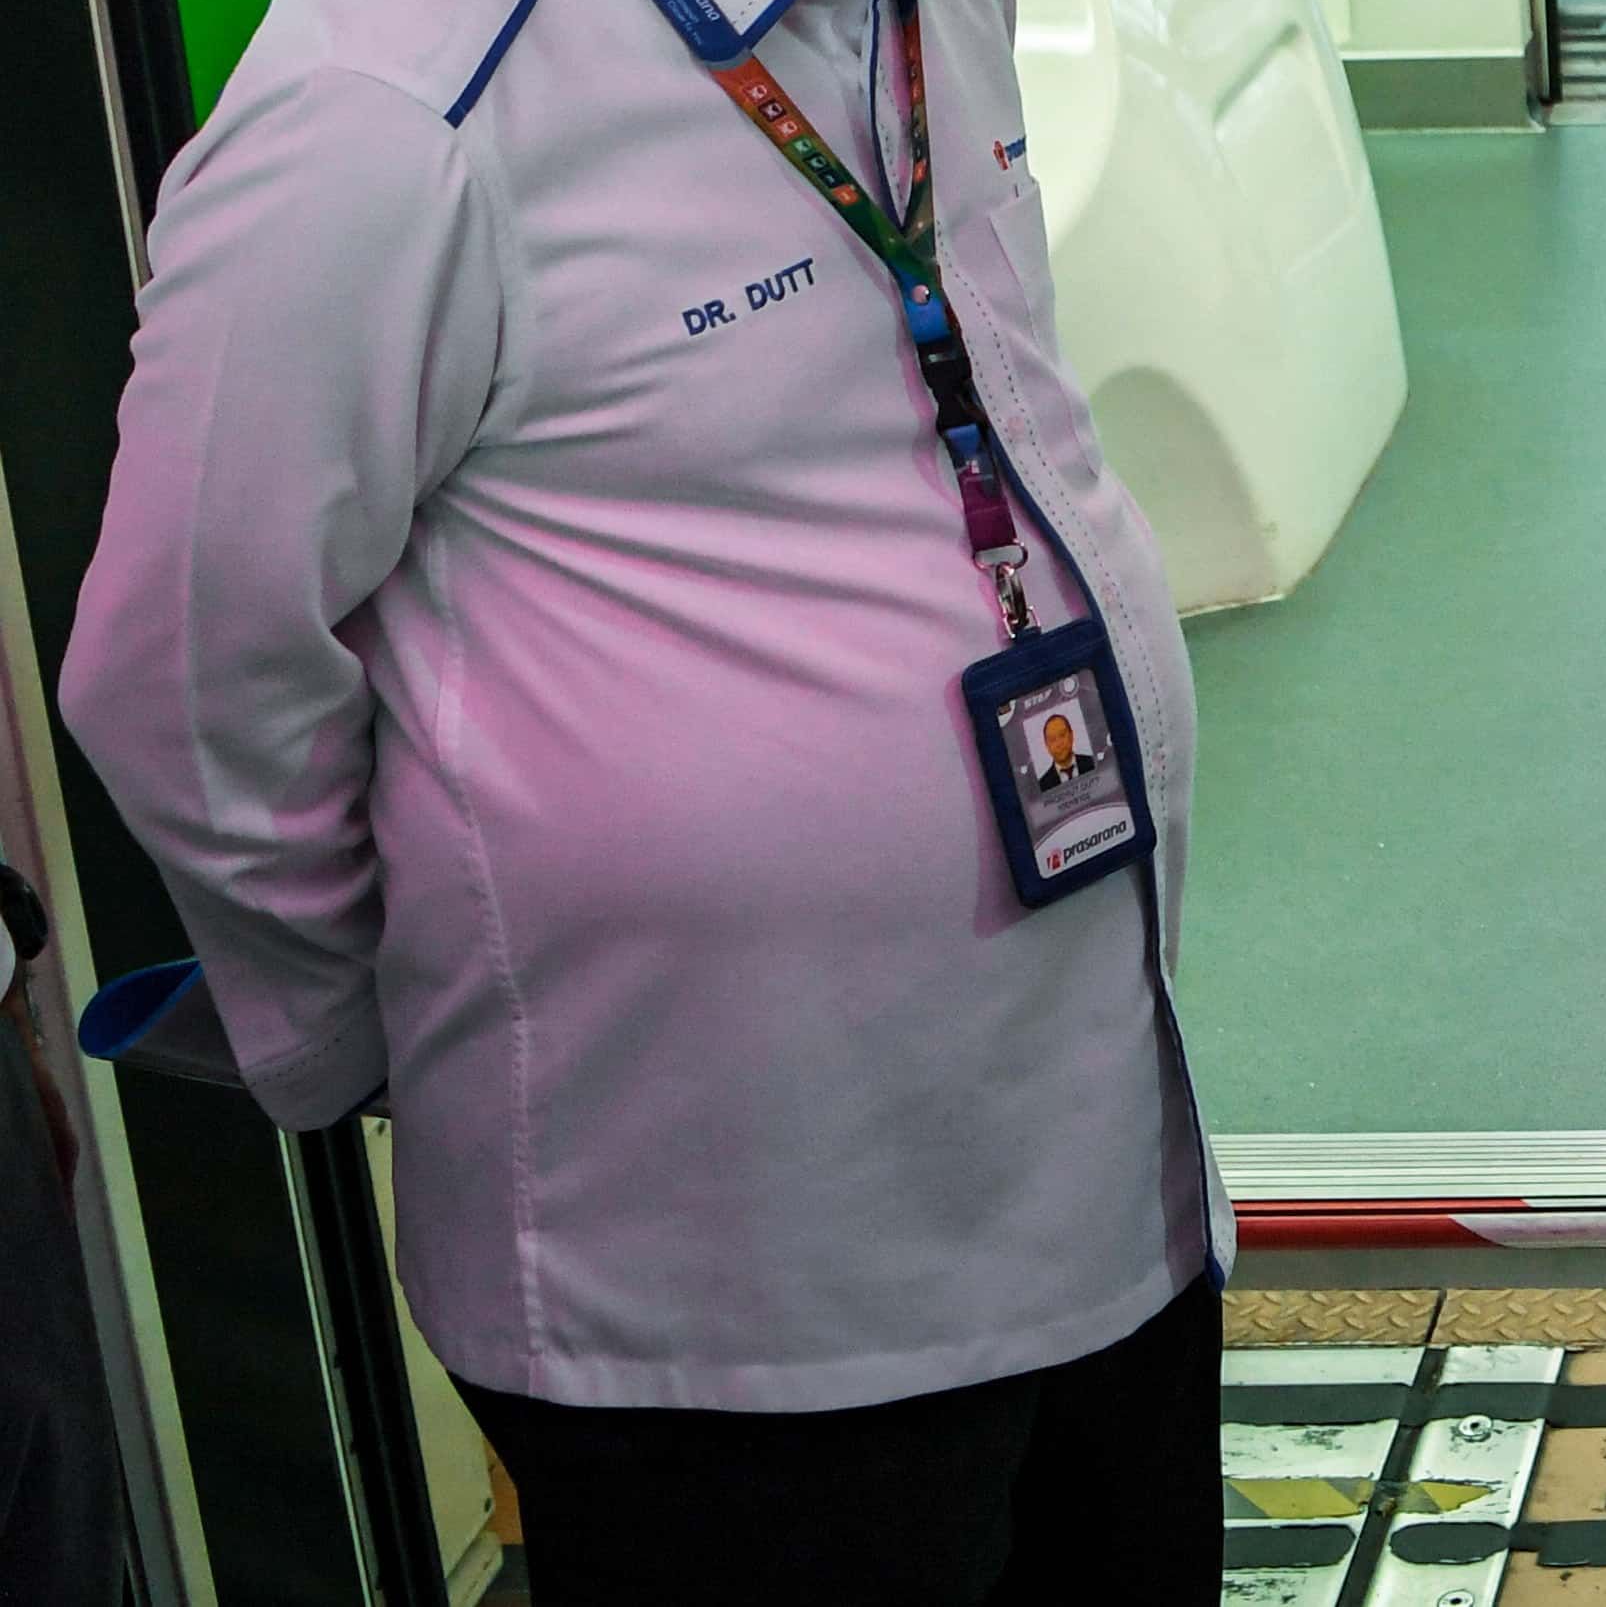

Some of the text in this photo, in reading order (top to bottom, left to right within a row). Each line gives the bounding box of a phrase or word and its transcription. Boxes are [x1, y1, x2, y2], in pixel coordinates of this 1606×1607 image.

[681, 257, 815, 336] DR. DUTT
[1062, 818, 1128, 864] prasarana
